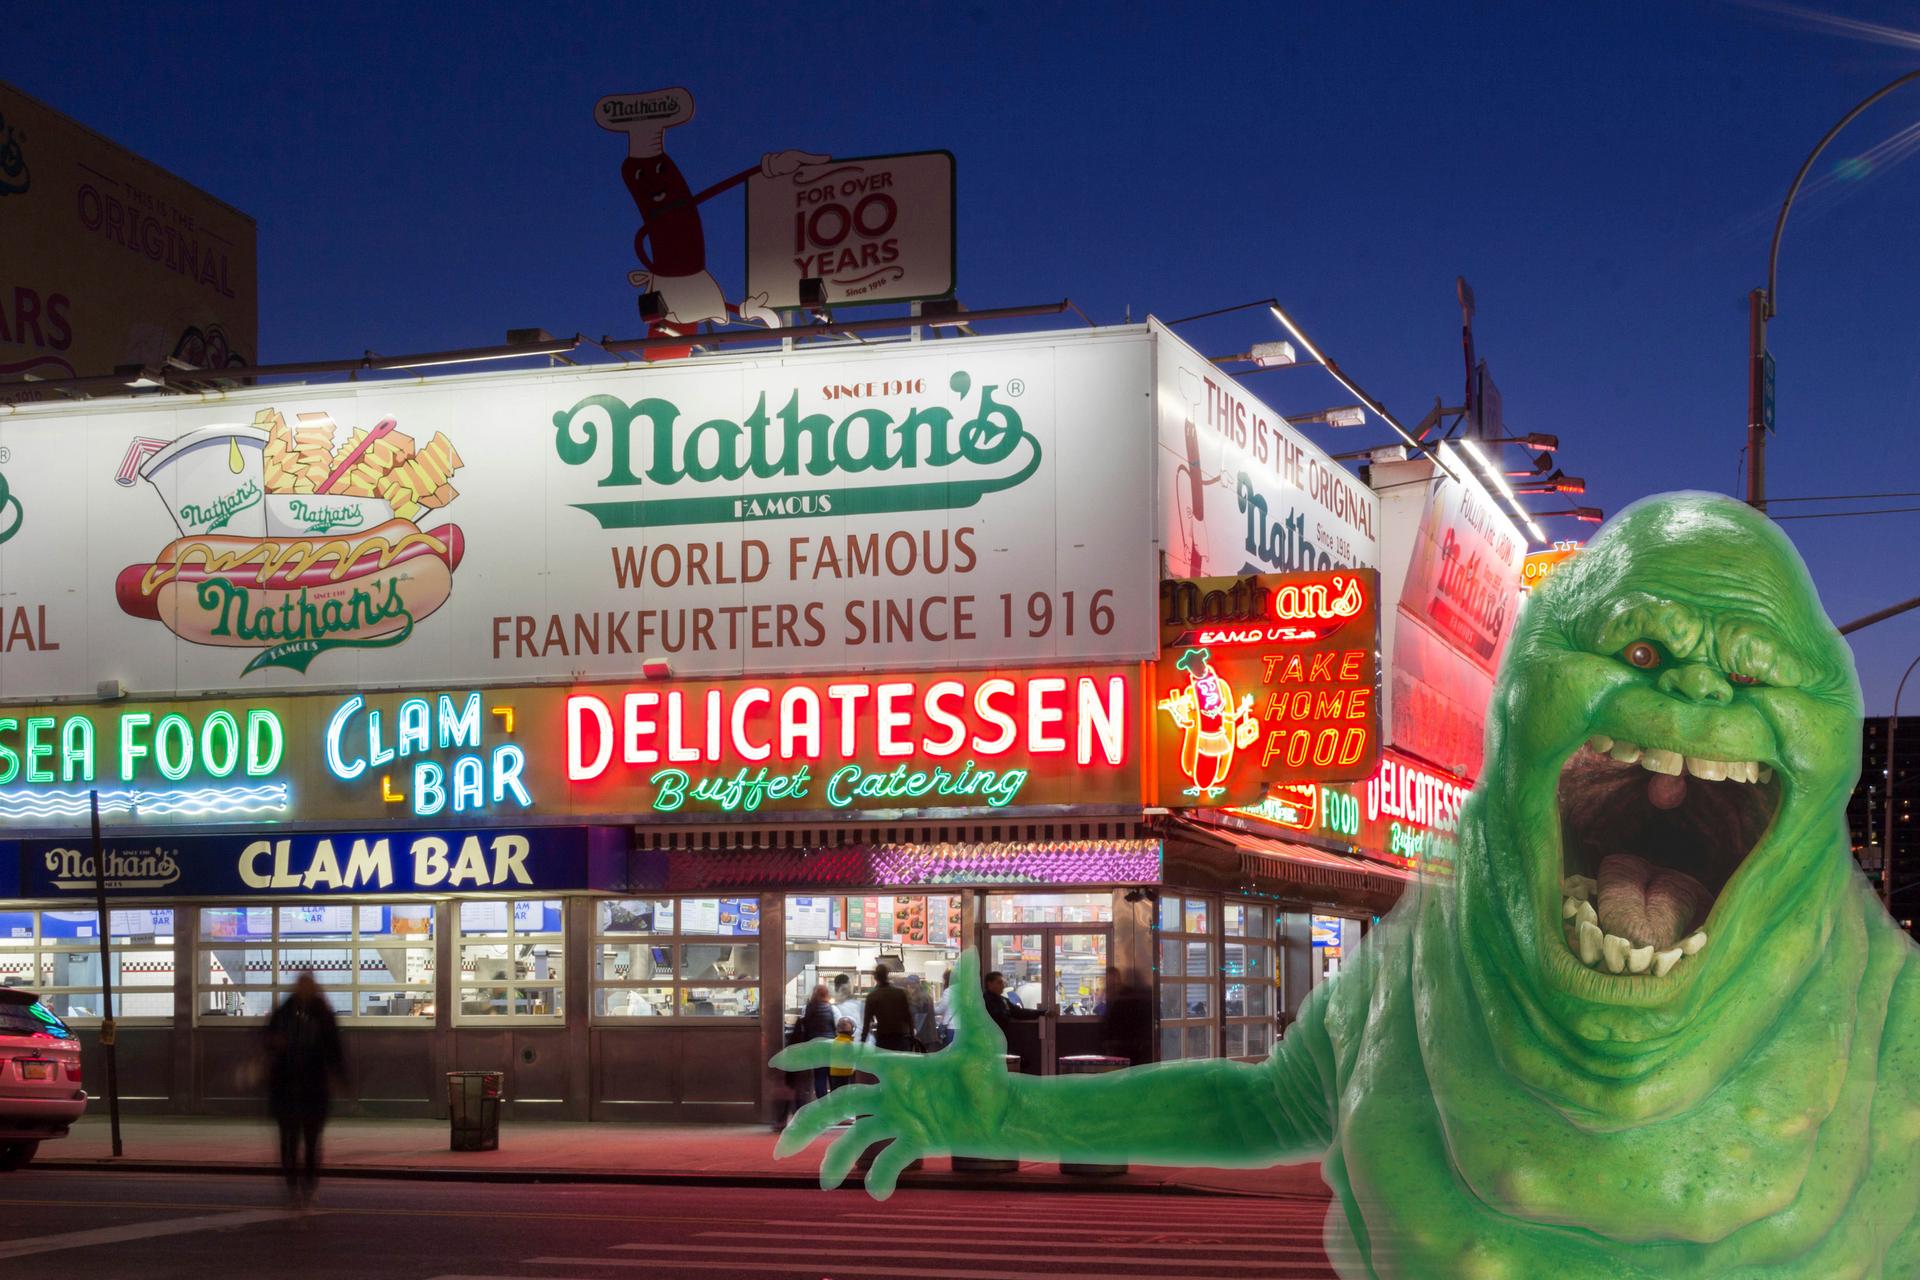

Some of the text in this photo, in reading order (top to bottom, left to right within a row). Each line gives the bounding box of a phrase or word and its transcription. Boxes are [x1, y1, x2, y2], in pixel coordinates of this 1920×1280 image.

[604, 96, 681, 117] Nathan's
[796, 172, 893, 208] FOR OVER
[78, 184, 235, 298] ORIGINAL
[172, 207, 195, 233] THE
[795, 193, 898, 253] 100
[794, 239, 899, 279] YEARS
[846, 279, 887, 297] Since 1916
[822, 378, 928, 400] SINCE 1916
[552, 370, 1041, 487] Nathan's
[1203, 375, 1376, 543] THIS IS THE ORIGINAL
[179, 479, 262, 528] Nathan's
[289, 500, 363, 524] Nathan's
[733, 494, 832, 518] FAMOUS
[611, 527, 977, 589] WORLD FAMOUS
[1316, 522, 1350, 561] Since 1916
[197, 577, 413, 641] Nathan's
[492, 588, 1116, 660] FRANKFURTERS SINCE 1916
[1160, 576, 1363, 625] Nathan's
[0, 605, 60, 652] AL
[269, 641, 319, 660] FAMOUS
[1262, 651, 1365, 684] TAKE
[566, 676, 1125, 781] DELICATESSEN
[1264, 688, 1370, 722] HOME
[0, 708, 284, 784] SEA FOOD
[326, 692, 483, 781] CLAM
[1261, 728, 1367, 768] FOOD
[414, 744, 533, 815] BAR
[651, 760, 1028, 811] Buffet Catering
[1321, 787, 1359, 835] FOOD
[45, 847, 180, 878] Nathan's
[238, 834, 535, 890] CLAM BAR
[1391, 822, 1424, 858] Buffet
